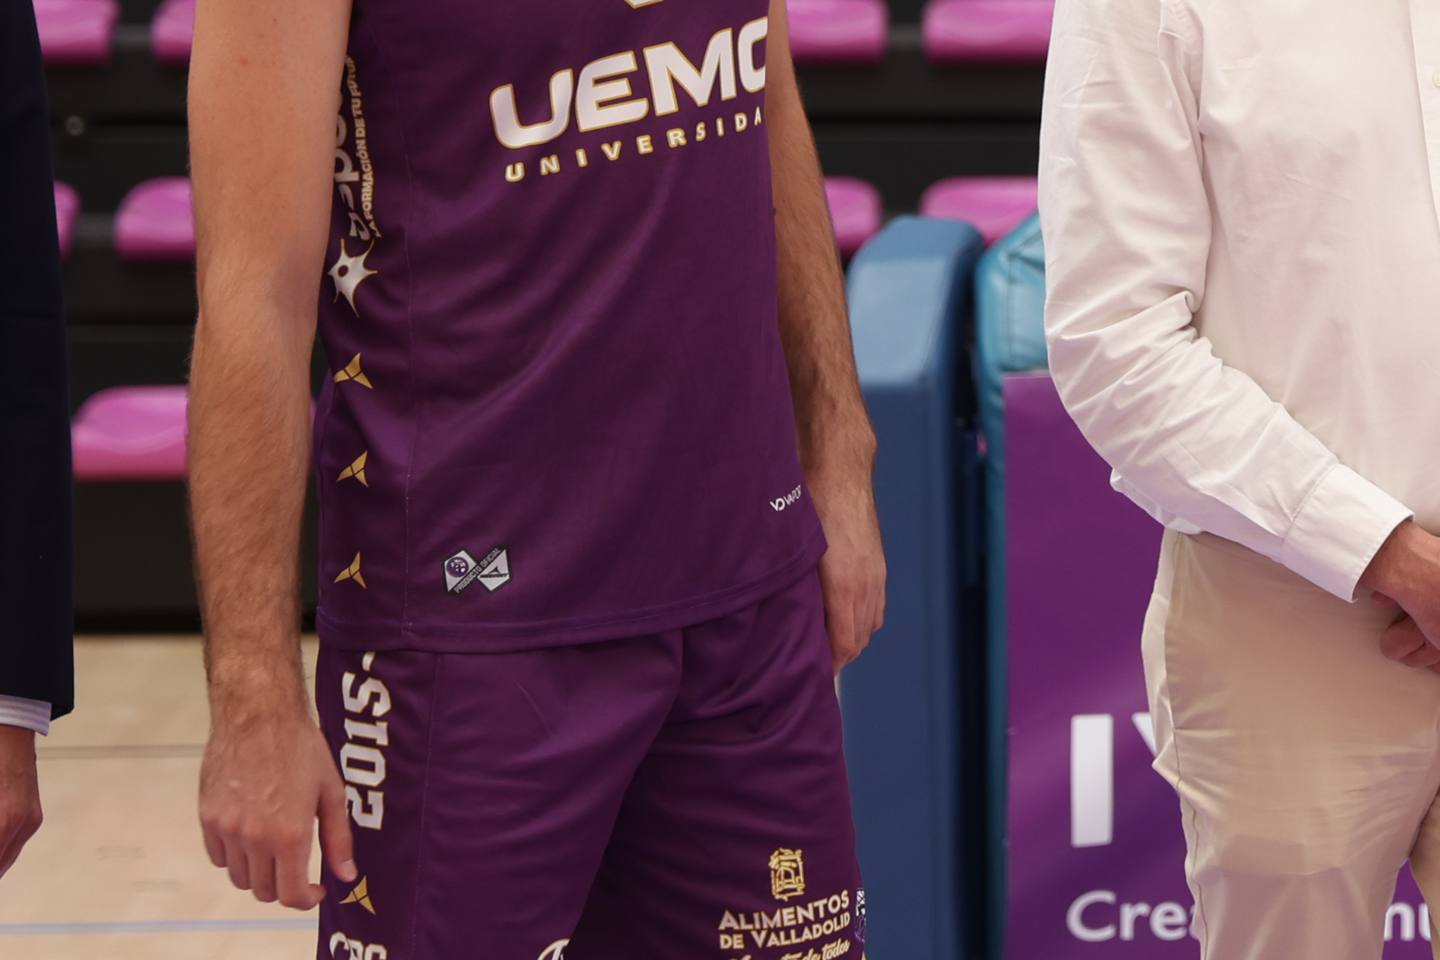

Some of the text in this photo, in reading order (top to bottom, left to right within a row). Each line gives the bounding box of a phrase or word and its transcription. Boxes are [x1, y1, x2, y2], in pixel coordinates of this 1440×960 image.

[504, 105, 763, 183] UNIVERSIDA
[718, 889, 850, 931] ALIMENTOS
[719, 934, 745, 950] DE
[750, 912, 851, 949] VALLADOLID
[1065, 890, 1197, 942] Cre
